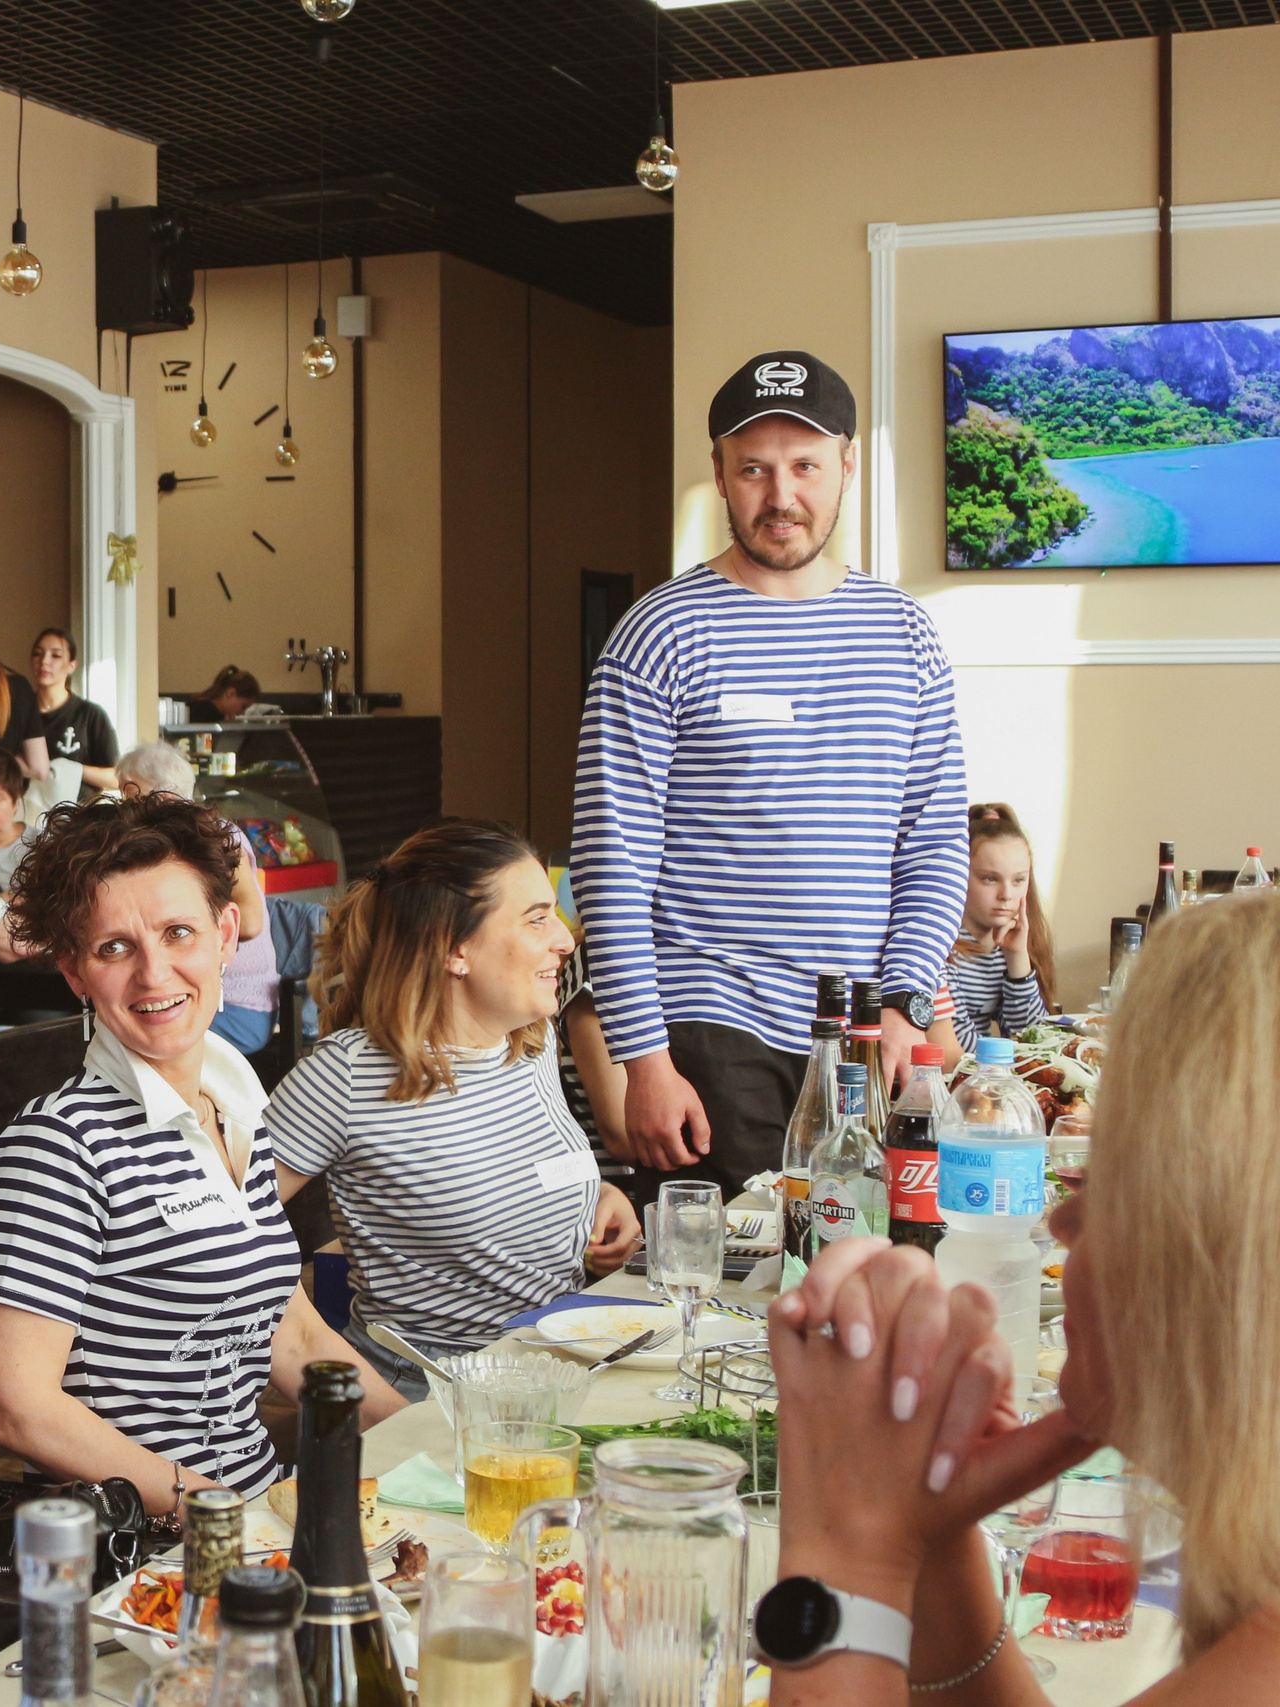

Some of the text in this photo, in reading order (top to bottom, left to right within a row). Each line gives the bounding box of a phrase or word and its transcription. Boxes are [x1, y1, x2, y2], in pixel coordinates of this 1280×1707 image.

[160, 360, 192, 378] 12
[164, 384, 188, 392] TIME
[755, 387, 805, 398] HINO
[812, 1201, 855, 1219] MARTINI
